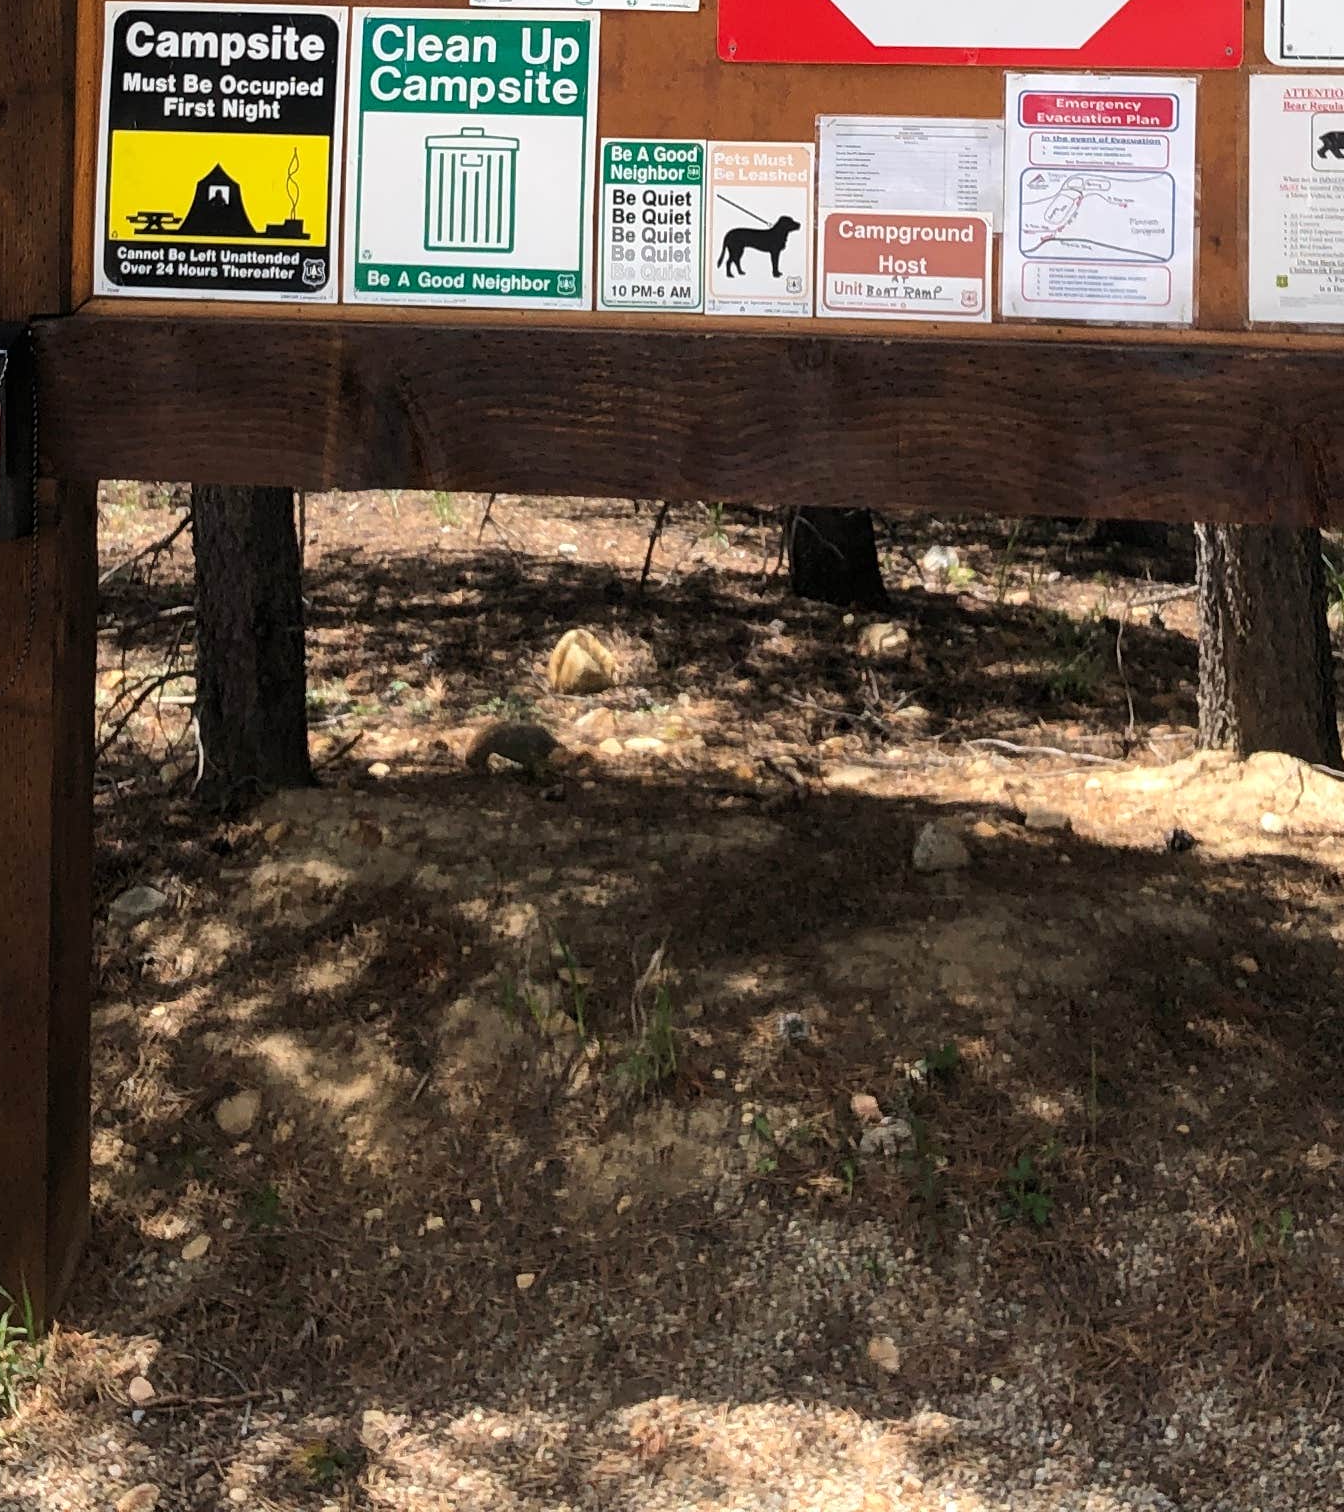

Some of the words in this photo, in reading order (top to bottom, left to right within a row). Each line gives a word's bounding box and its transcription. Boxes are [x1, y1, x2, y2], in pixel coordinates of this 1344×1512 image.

[126, 21, 325, 65] Campsite
[372, 23, 496, 62] Clean
[521, 27, 579, 72] Up
[123, 72, 176, 92] Must
[183, 73, 212, 93] Be
[219, 74, 323, 97] Occupied
[370, 65, 577, 109] Campsite
[163, 96, 215, 117] First
[222, 98, 280, 121] Night
[1055, 97, 1141, 111] Emergency
[1283, 102, 1306, 111] Bear
[1036, 112, 1121, 125] Evacuation
[1126, 114, 1159, 125] Plan
[611, 145, 632, 161] Be
[636, 145, 649, 161] A
[653, 145, 697, 162] Good
[713, 152, 749, 166] Pets
[753, 153, 793, 167] Must
[610, 163, 685, 183] Neighbor
[713, 167, 735, 180] Be
[738, 168, 807, 182] Leashed
[612, 189, 636, 205] Be
[642, 189, 691, 206] Quiet
[612, 208, 636, 224] Be
[642, 208, 691, 226] Quiet
[611, 226, 635, 243] Be
[641, 227, 691, 244] Quiet
[838, 219, 973, 244] Campground
[117, 246, 164, 260] Cannot
[168, 248, 186, 261] Be
[189, 249, 216, 262] Left
[220, 249, 299, 265] Unattended
[611, 244, 635, 261] Be
[640, 245, 691, 263] Quiet
[120, 261, 152, 274] Over
[155, 262, 174, 275] 24
[177, 262, 218, 277] Hours
[221, 264, 295, 279] Thereafter
[878, 254, 927, 274] Host
[367, 269, 390, 286] Be
[397, 270, 410, 286] A
[417, 271, 464, 288] Good
[472, 273, 551, 293] Neighbor
[834, 280, 862, 296] Unit
[611, 284, 626, 297] 10
[631, 285, 664, 297] PM-6
[669, 285, 691, 298] AM
